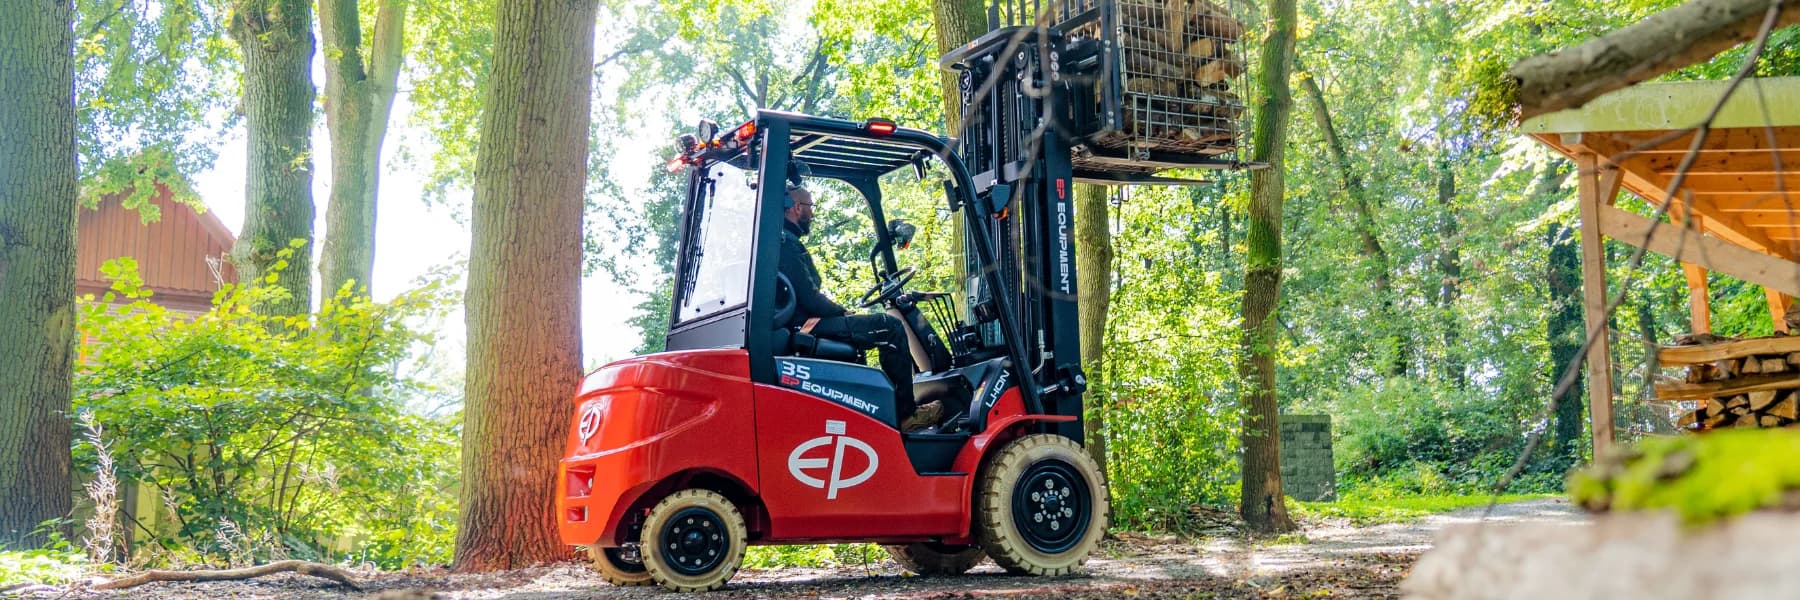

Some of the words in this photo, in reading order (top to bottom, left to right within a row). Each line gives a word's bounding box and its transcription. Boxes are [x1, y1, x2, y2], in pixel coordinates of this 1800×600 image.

[1056, 178, 1066, 199] EP
[1057, 202, 1070, 295] EQUIPMENT
[782, 361, 811, 380] 35
[781, 374, 800, 386] EP
[801, 380, 880, 414] EQUIPMENT
[788, 435, 879, 500] EP
